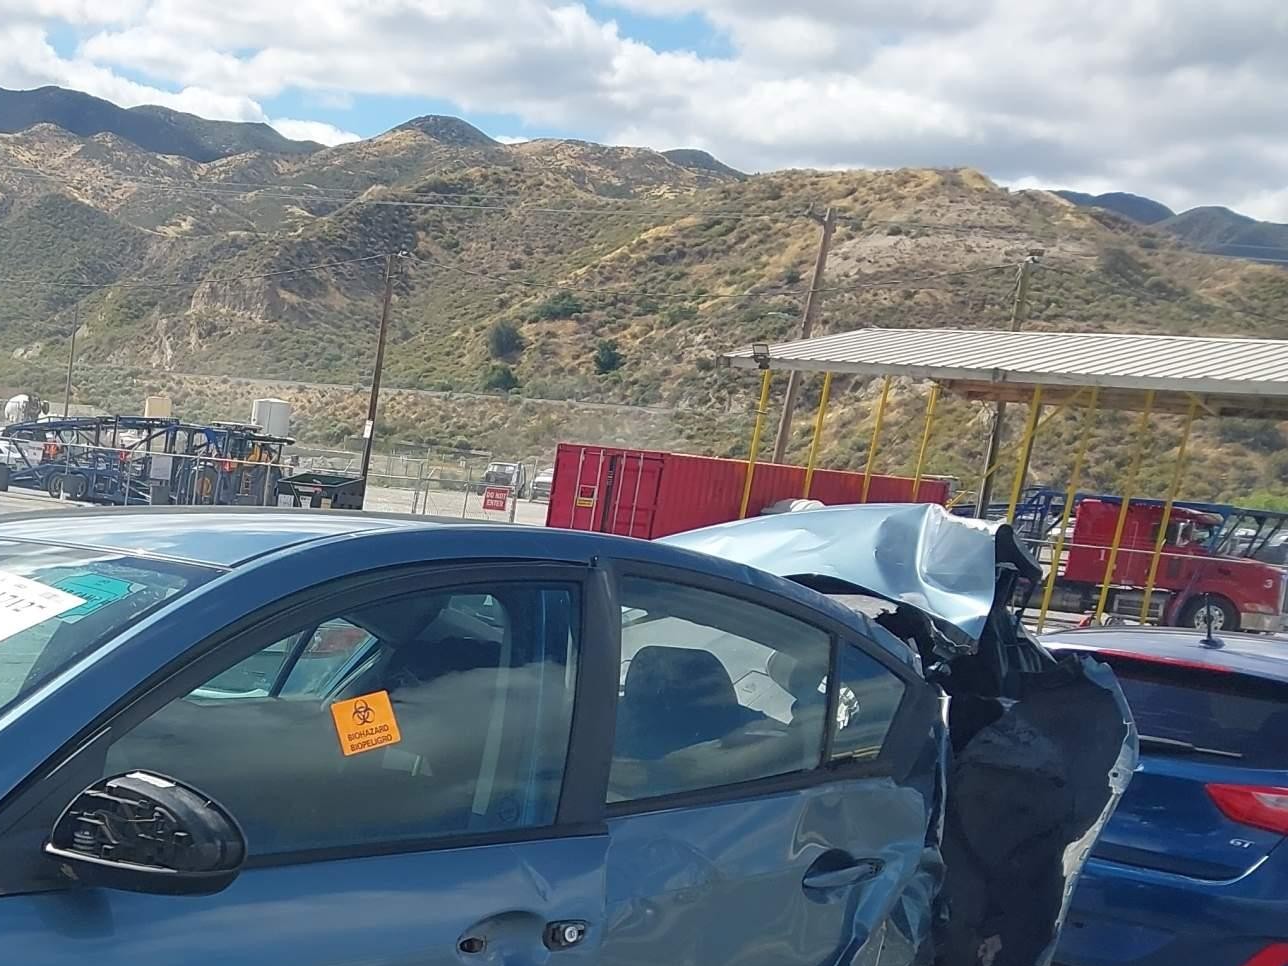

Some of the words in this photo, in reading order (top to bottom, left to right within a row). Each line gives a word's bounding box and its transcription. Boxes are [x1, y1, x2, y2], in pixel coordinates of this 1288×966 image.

[347, 724, 389, 741] BIOHAZARD
[350, 734, 393, 752] BIOPELIGRO
[1229, 838, 1256, 849] GT
